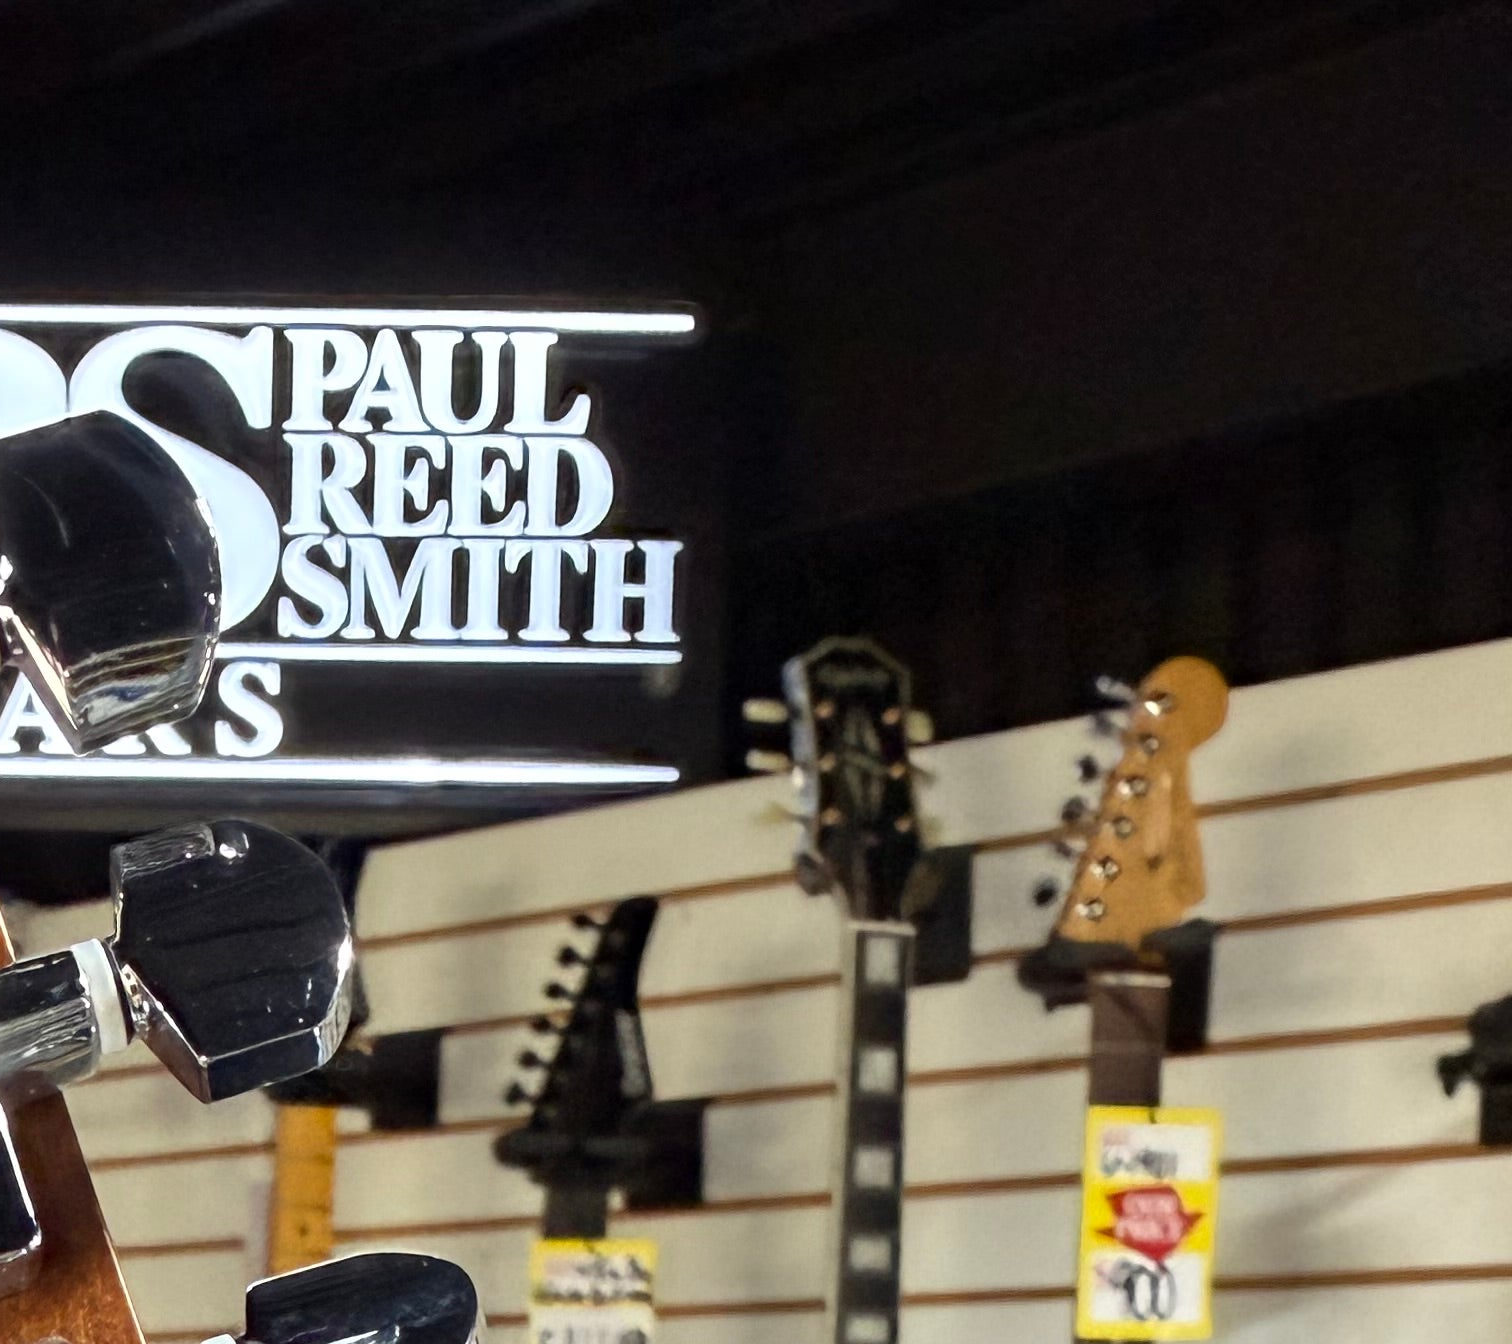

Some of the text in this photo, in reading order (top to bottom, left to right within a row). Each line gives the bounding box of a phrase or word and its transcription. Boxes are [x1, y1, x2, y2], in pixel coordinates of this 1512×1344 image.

[282, 327, 592, 436] PAUL
[282, 431, 615, 538] REED
[276, 533, 685, 644] SMITH
